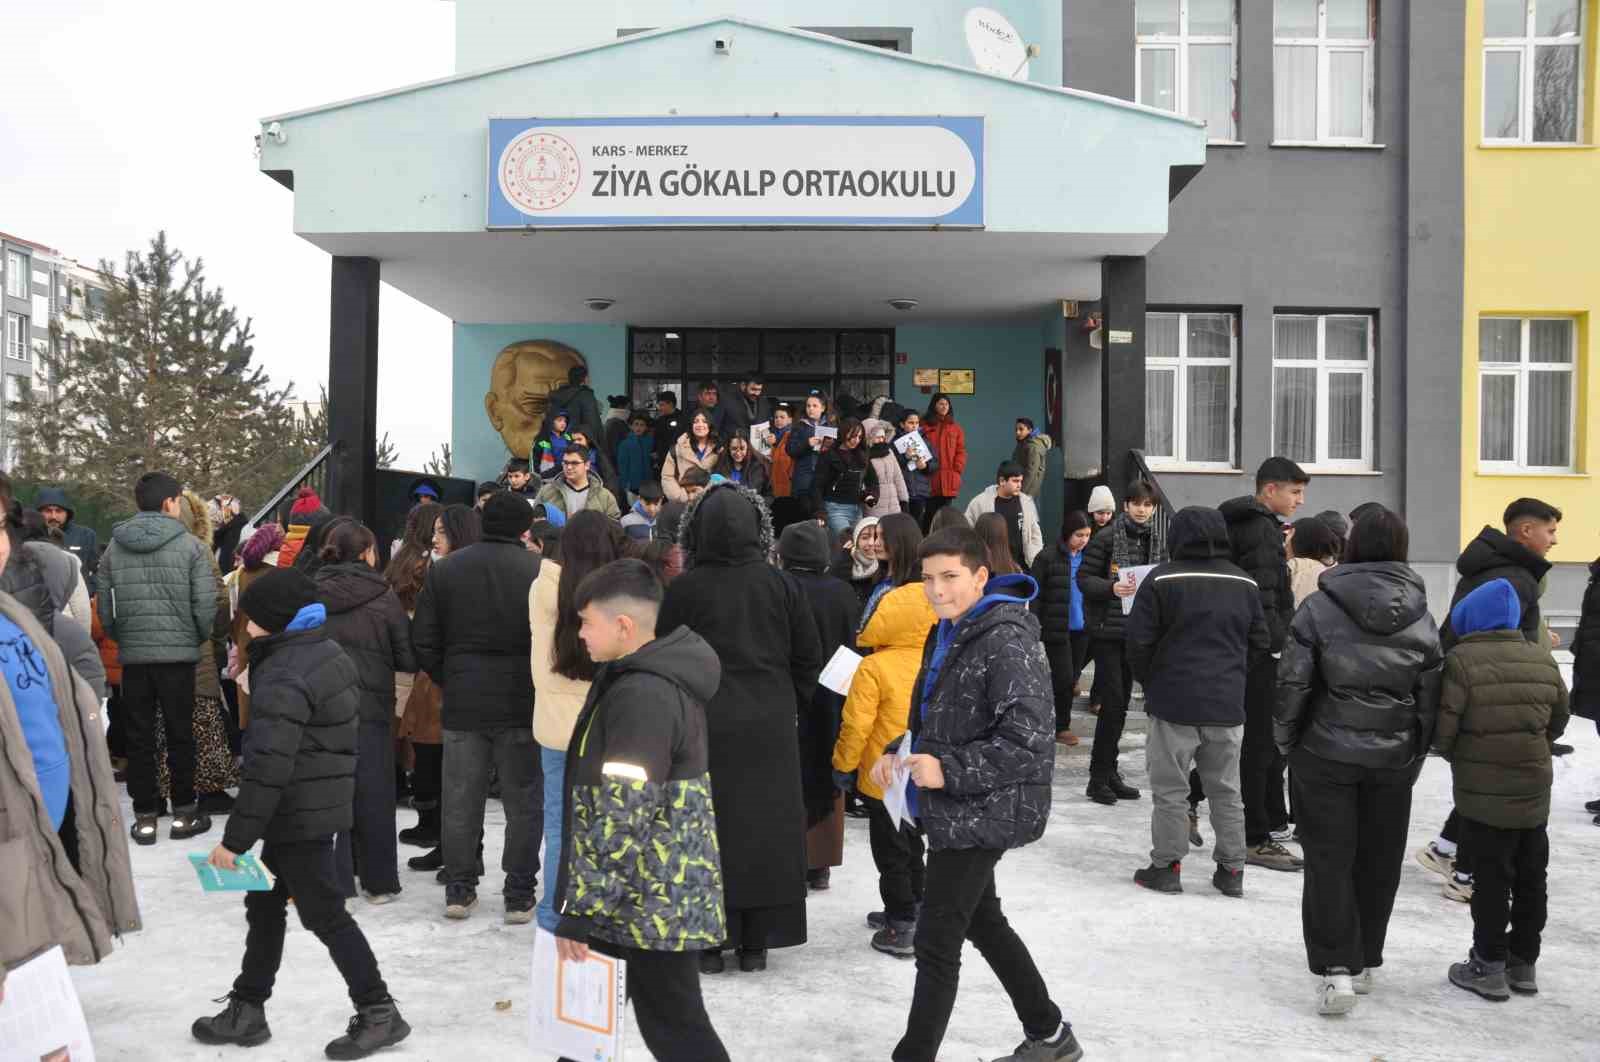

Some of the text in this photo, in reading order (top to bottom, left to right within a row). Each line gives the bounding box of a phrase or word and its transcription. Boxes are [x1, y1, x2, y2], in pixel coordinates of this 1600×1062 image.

[592, 146, 626, 157] KARS
[635, 146, 688, 156] MERKEZ
[591, 164, 653, 197] ZİYA
[659, 164, 776, 197] GÖKALP
[782, 170, 955, 198] ORTAOKULU
